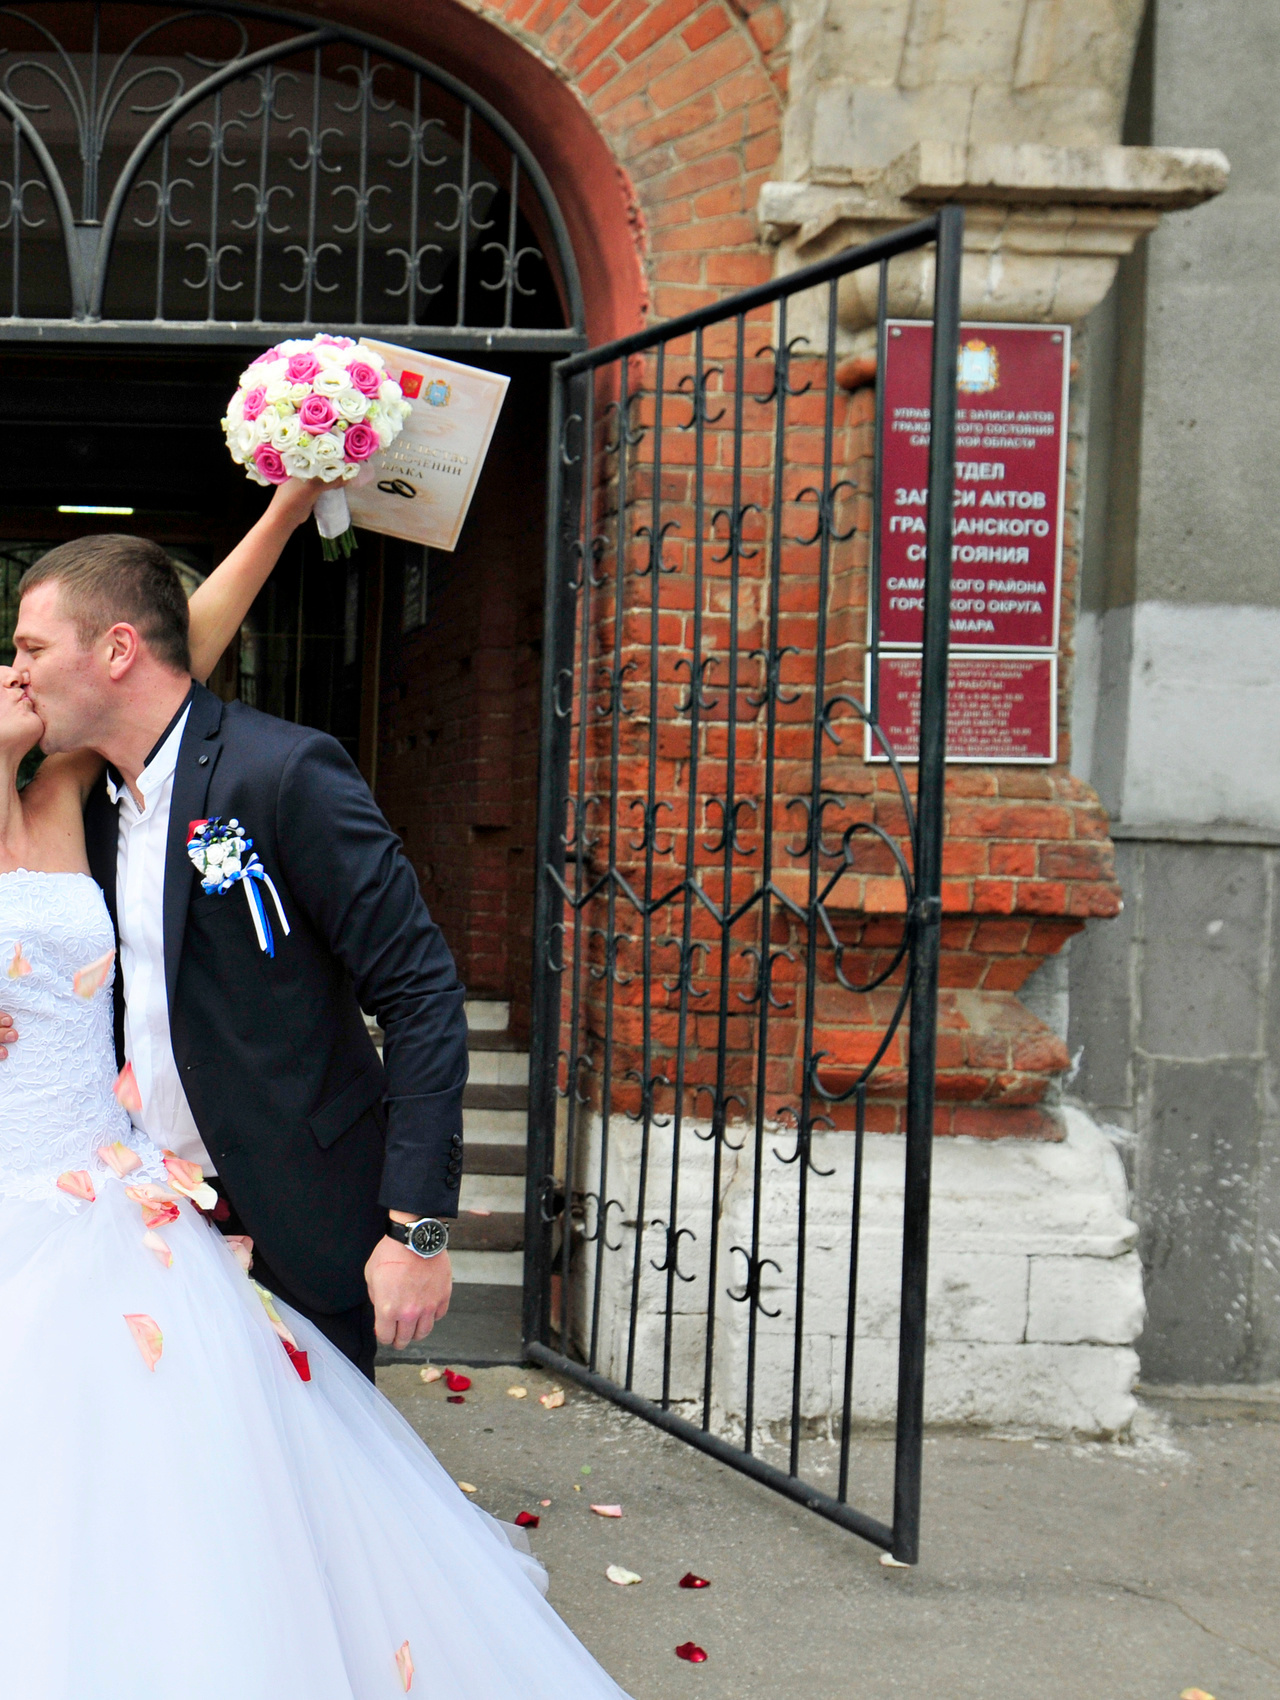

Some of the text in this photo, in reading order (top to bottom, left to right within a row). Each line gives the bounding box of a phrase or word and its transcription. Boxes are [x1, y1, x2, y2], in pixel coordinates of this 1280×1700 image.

[970, 410, 1014, 421] ЗАПИСИ
[1017, 411, 1054, 422] АКТОВ
[985, 423, 1054, 435] СОСТОЯНИЯ
[982, 437, 1035, 448] ОБЛАСТИ
[954, 462, 1004, 480] ТДЕЛ
[980, 490, 1046, 509] АКТОВ
[890, 515, 1049, 537] ГРААНСКОГО
[907, 544, 1030, 564] СТОЯНИЯ
[987, 578, 1046, 594] РАЙОНА
[890, 597, 1042, 614] ГОРОКОГО ОКРУГА
[949, 619, 995, 632] АМАРА
